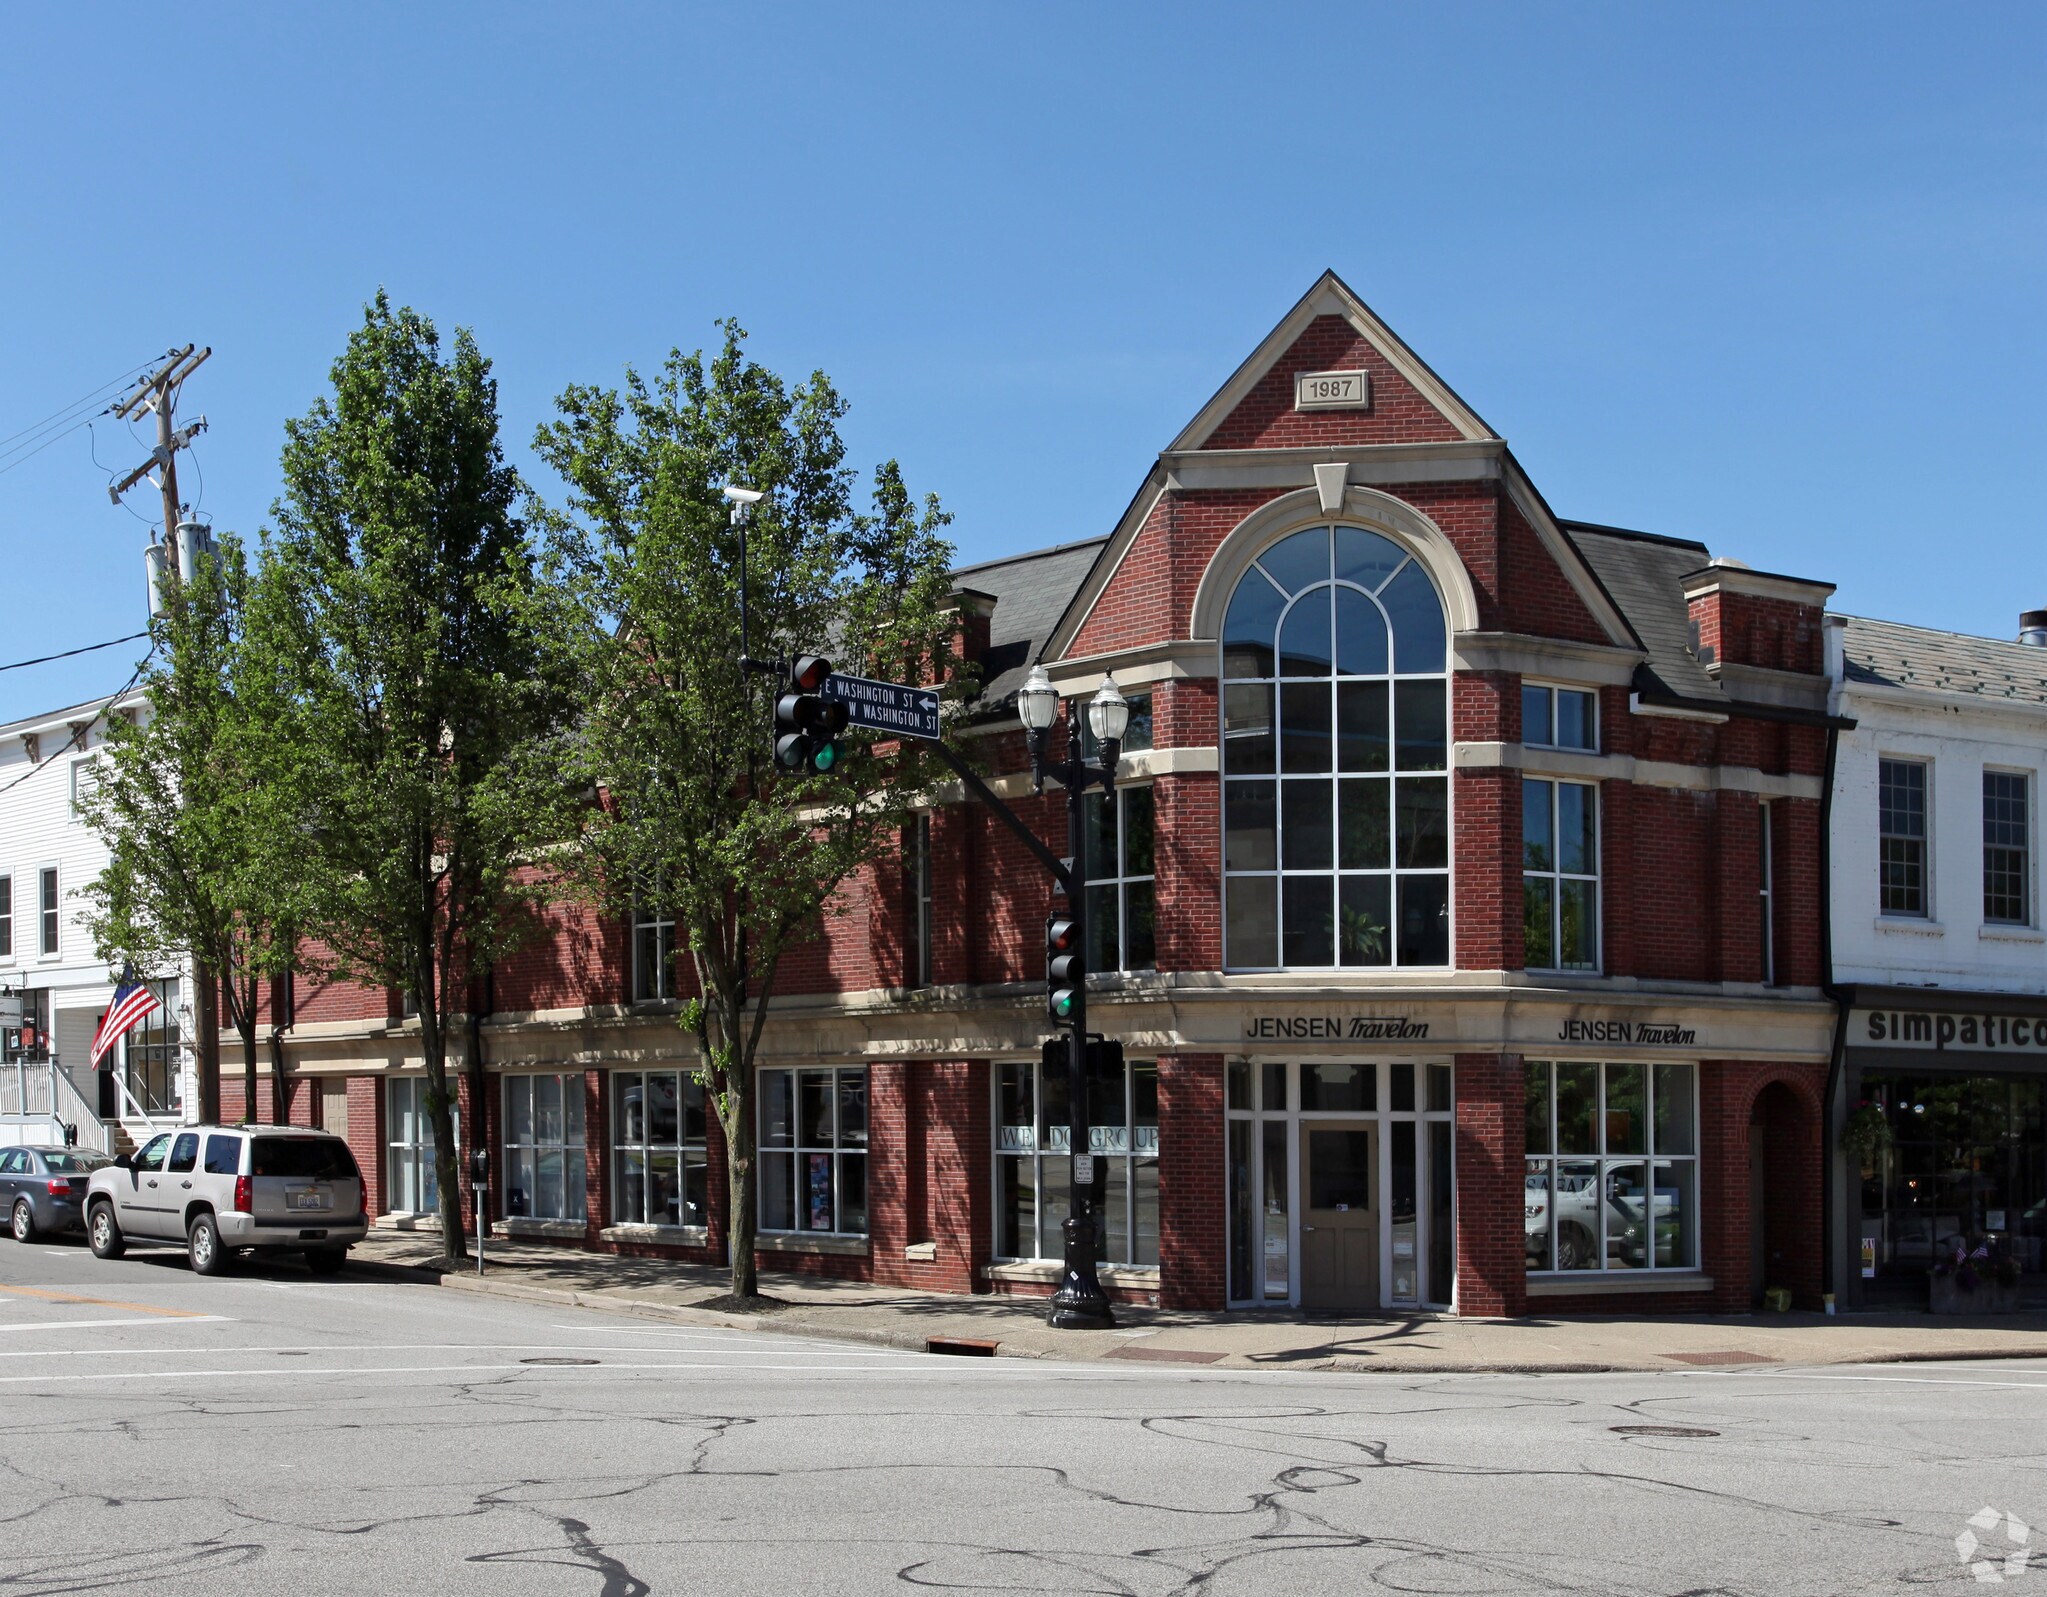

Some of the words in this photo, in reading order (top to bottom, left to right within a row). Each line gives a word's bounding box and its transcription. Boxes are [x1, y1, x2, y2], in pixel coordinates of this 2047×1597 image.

[1309, 380, 1353, 398] 1987
[825, 678, 831, 693] E
[837, 680, 895, 705] WASHINGTON
[903, 692, 914, 708] ST
[849, 701, 856, 716] W
[926, 715, 936, 731] ST
[1246, 1017, 1341, 1038] JENSEN
[1348, 1017, 1429, 1039] Travelon
[1558, 1020, 1631, 1042] JENSEN
[1636, 1023, 1696, 1045] Travelon
[1002, 1127, 1032, 1147] WE
[1089, 1127, 1158, 1148] GROUP
